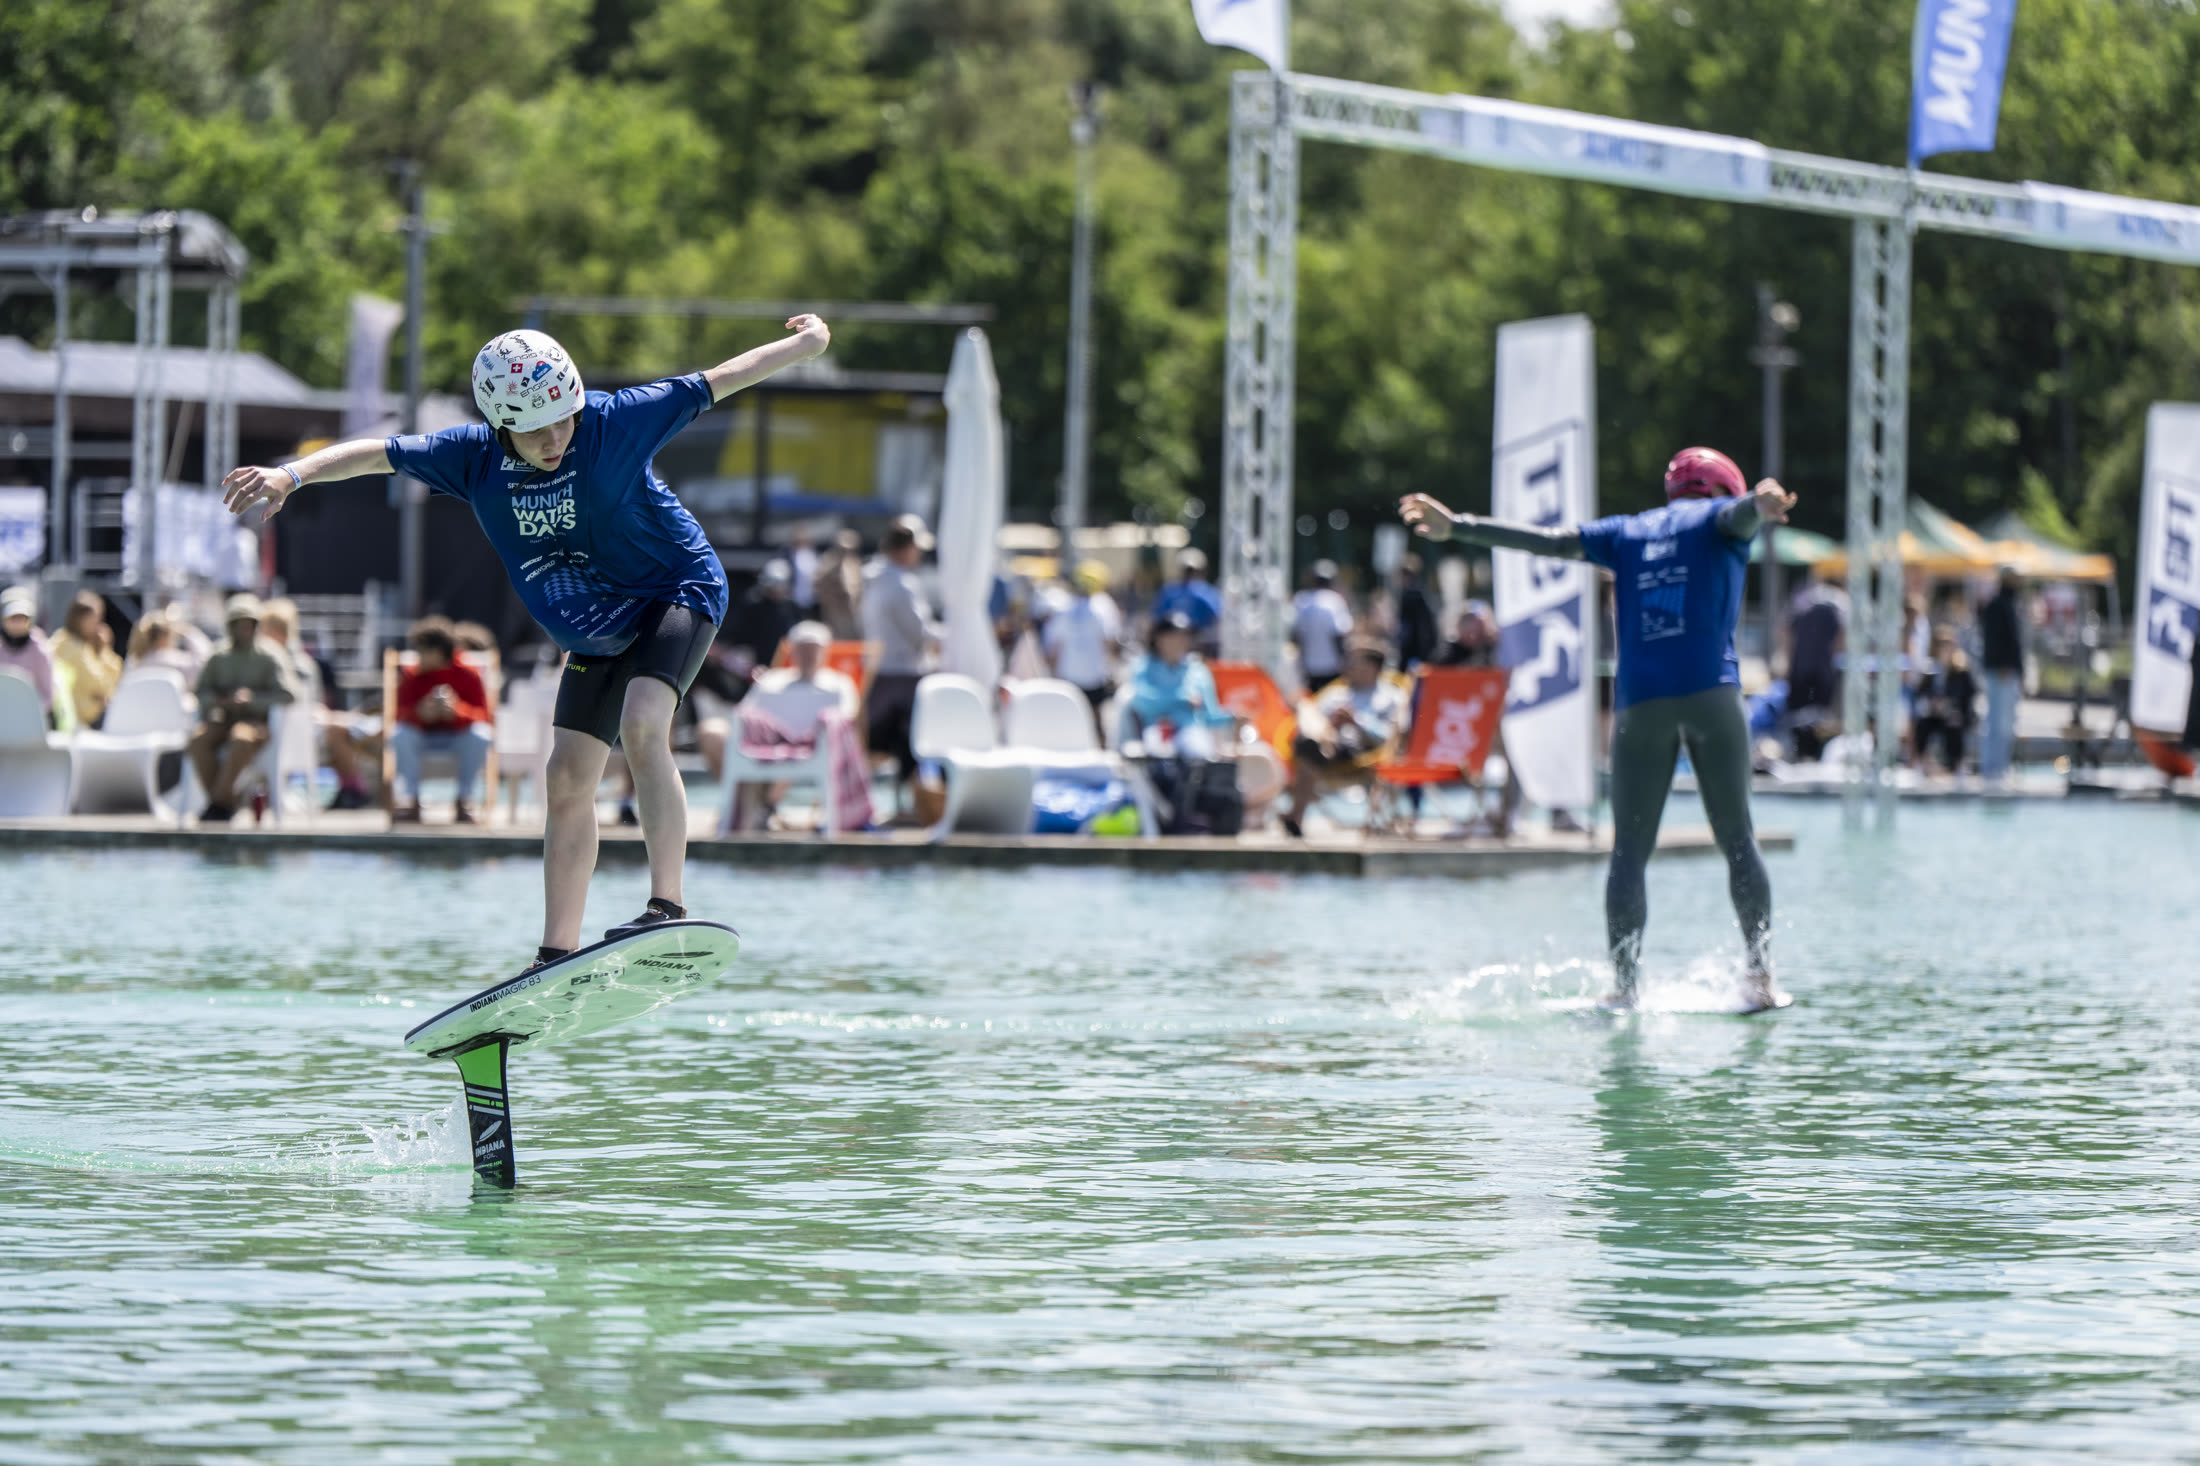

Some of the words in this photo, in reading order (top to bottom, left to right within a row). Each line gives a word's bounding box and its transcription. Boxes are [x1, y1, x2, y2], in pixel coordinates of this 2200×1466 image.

[511, 483, 573, 510] MUNICH
[566, 663, 588, 673] TURE
[633, 958, 695, 972] INDIANA
[528, 974, 542, 987] 83
[475, 1139, 506, 1158] INDIANA
